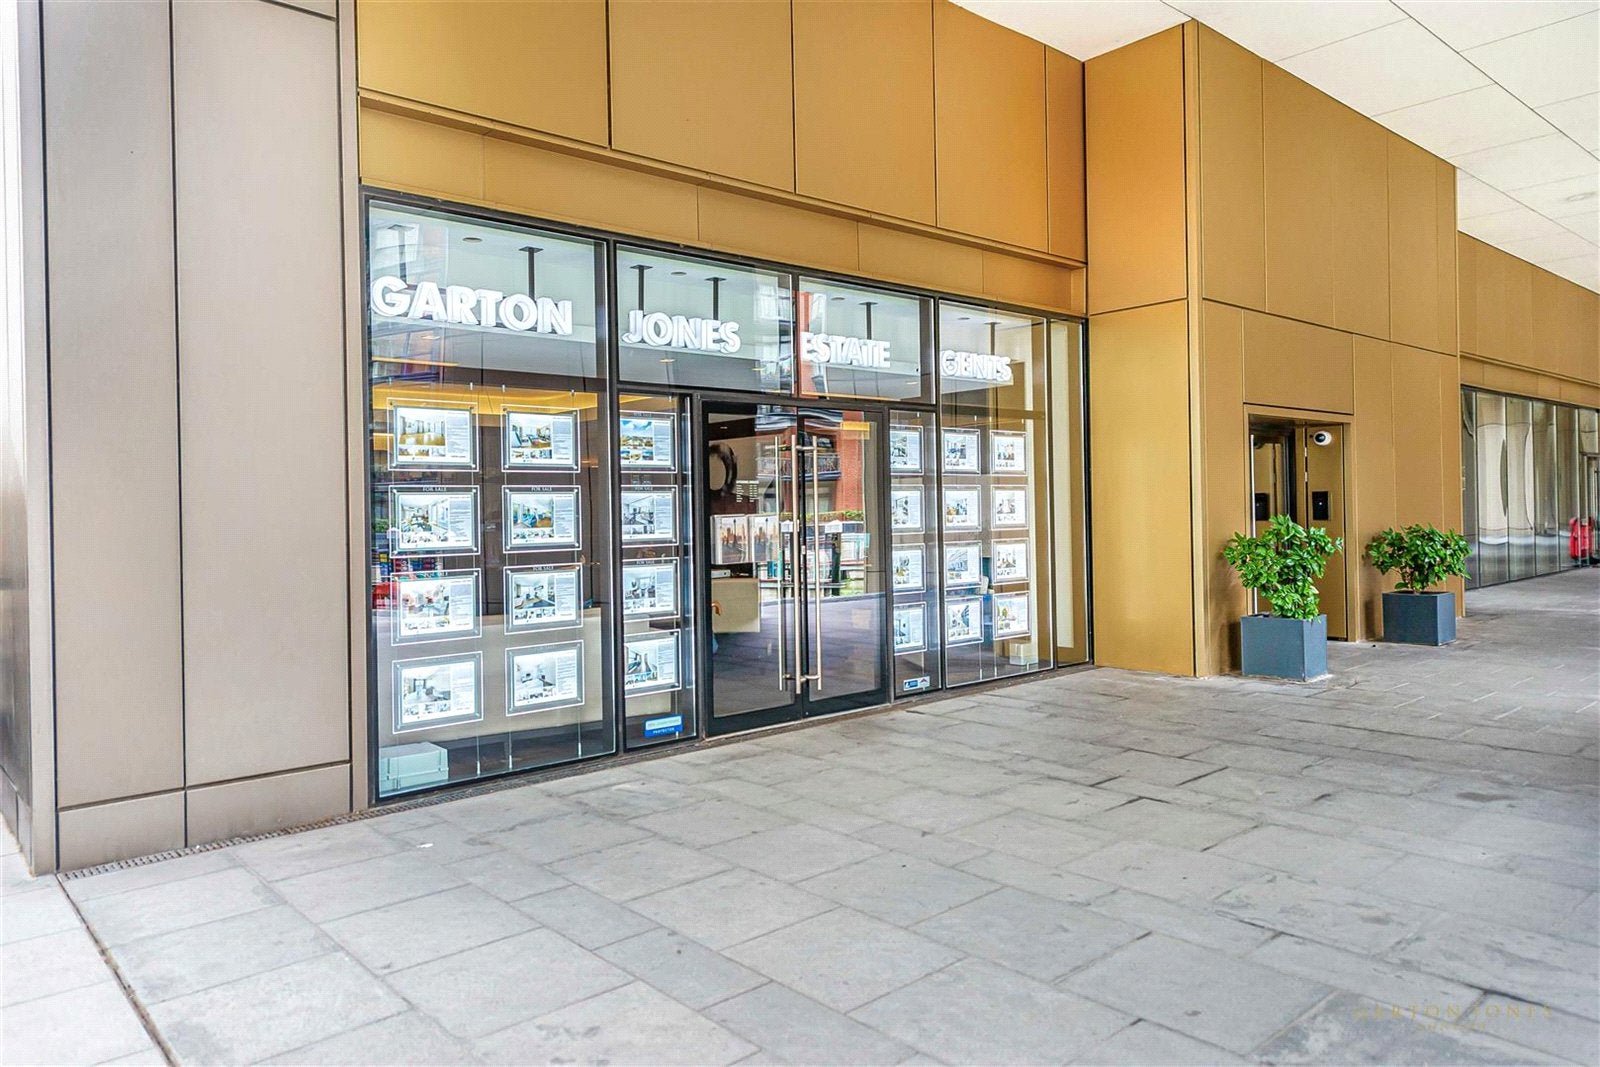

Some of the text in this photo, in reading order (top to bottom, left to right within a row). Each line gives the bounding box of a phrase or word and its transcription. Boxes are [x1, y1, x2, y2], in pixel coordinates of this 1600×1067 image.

[370, 275, 1012, 382] GARTON JONES ESTATE GENTS
